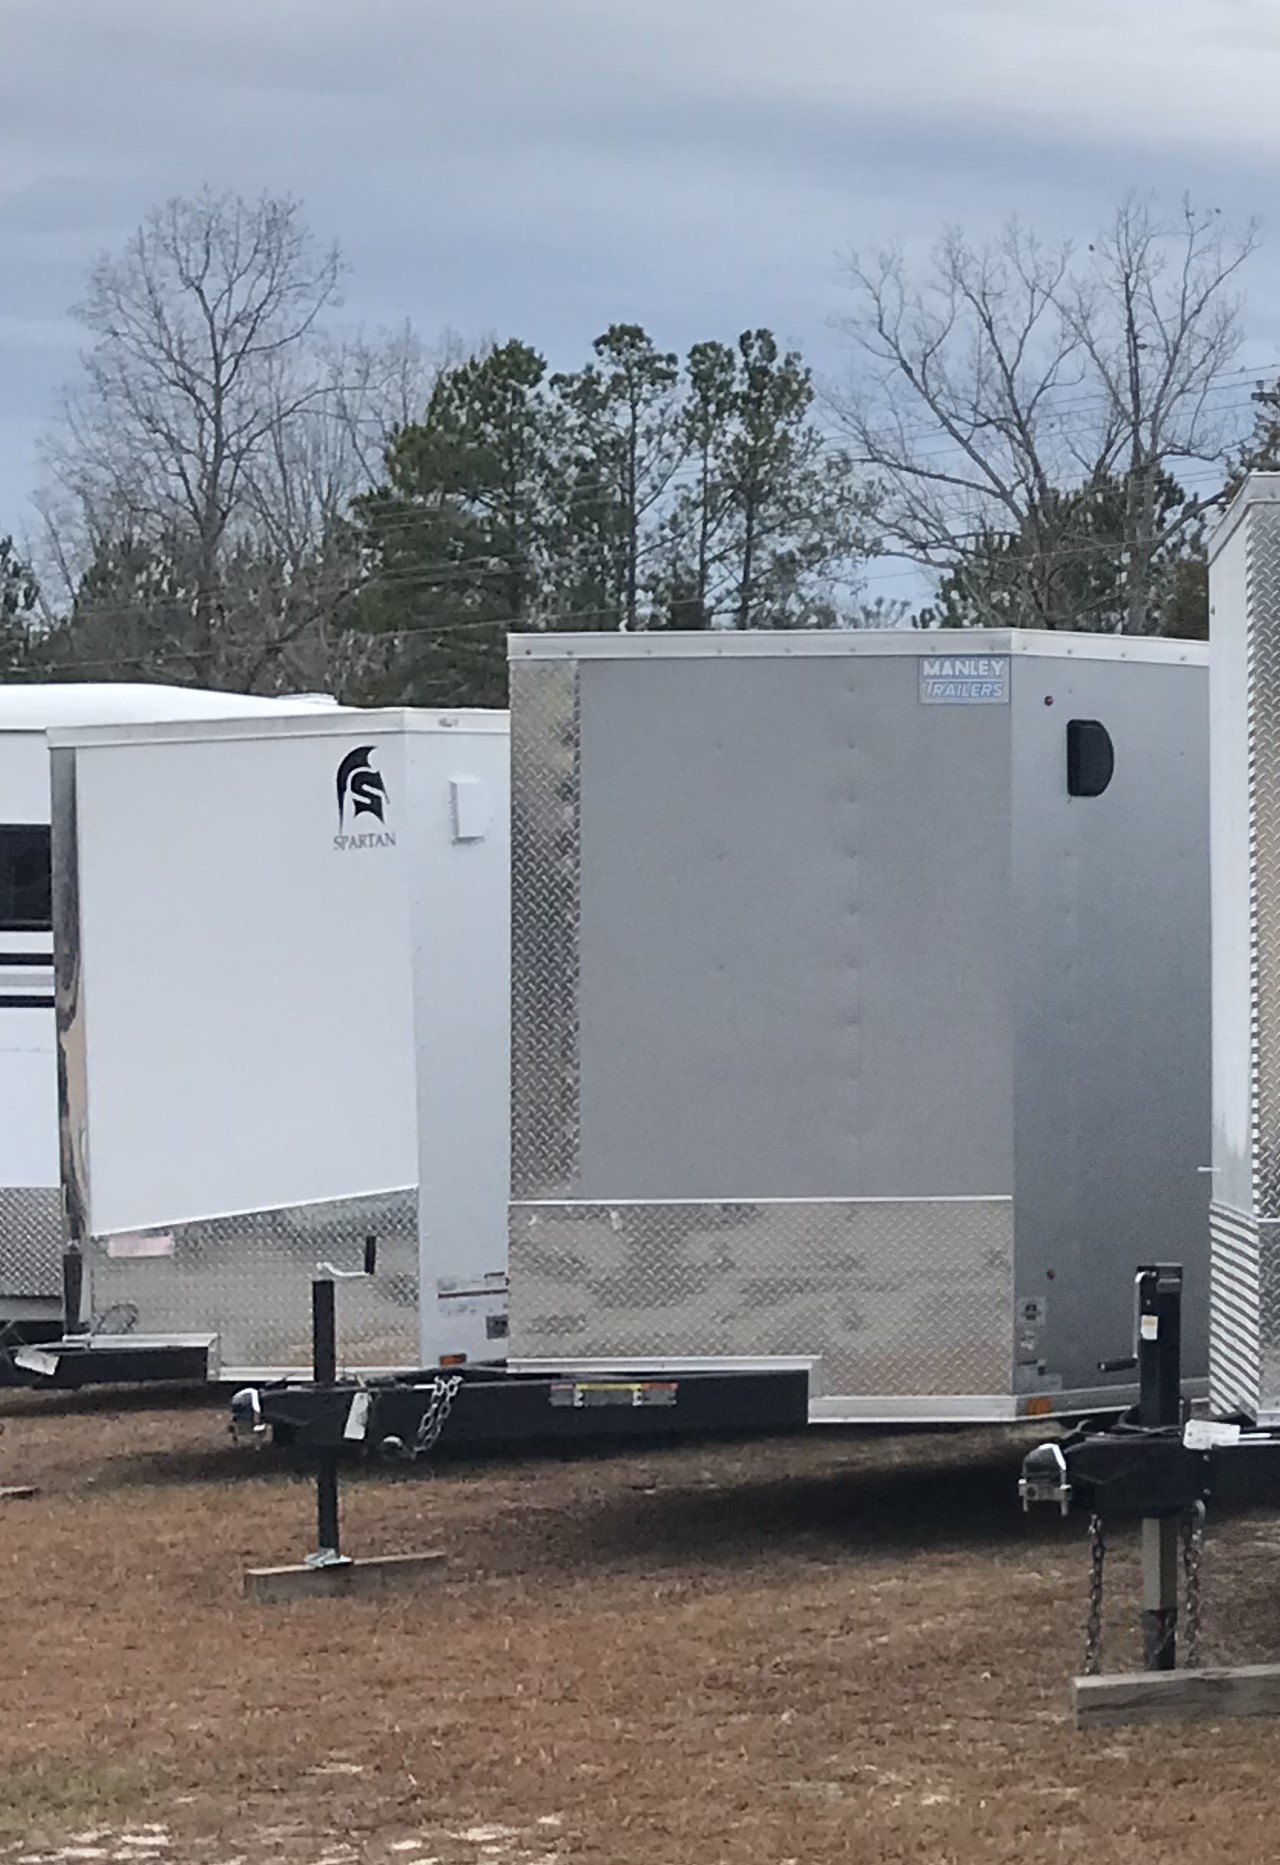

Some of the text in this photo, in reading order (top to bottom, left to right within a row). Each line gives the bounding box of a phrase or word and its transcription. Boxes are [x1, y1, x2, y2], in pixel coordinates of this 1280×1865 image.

[923, 660, 1004, 676] MANLEY
[924, 679, 1004, 698] TRAILERS
[333, 832, 396, 850] SPARTAN
